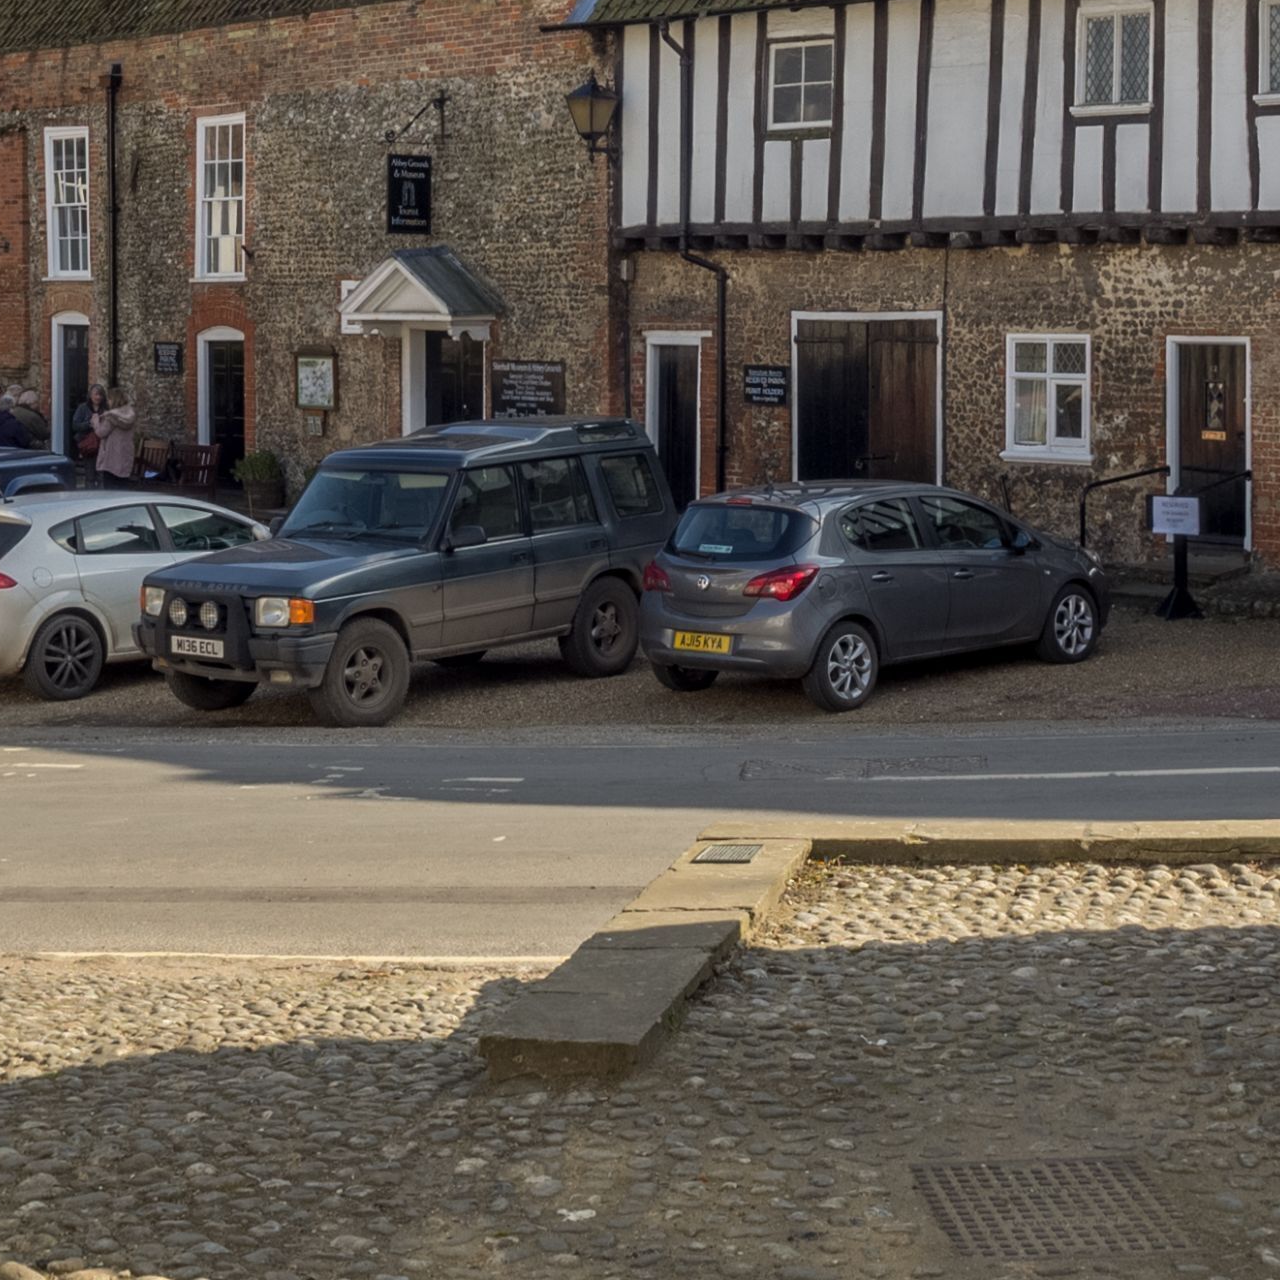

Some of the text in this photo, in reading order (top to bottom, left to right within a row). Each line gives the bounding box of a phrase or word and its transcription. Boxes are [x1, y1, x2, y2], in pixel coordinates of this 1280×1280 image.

[200, 641, 219, 655] ECL
[680, 634, 723, 649] AJ15 KYA
